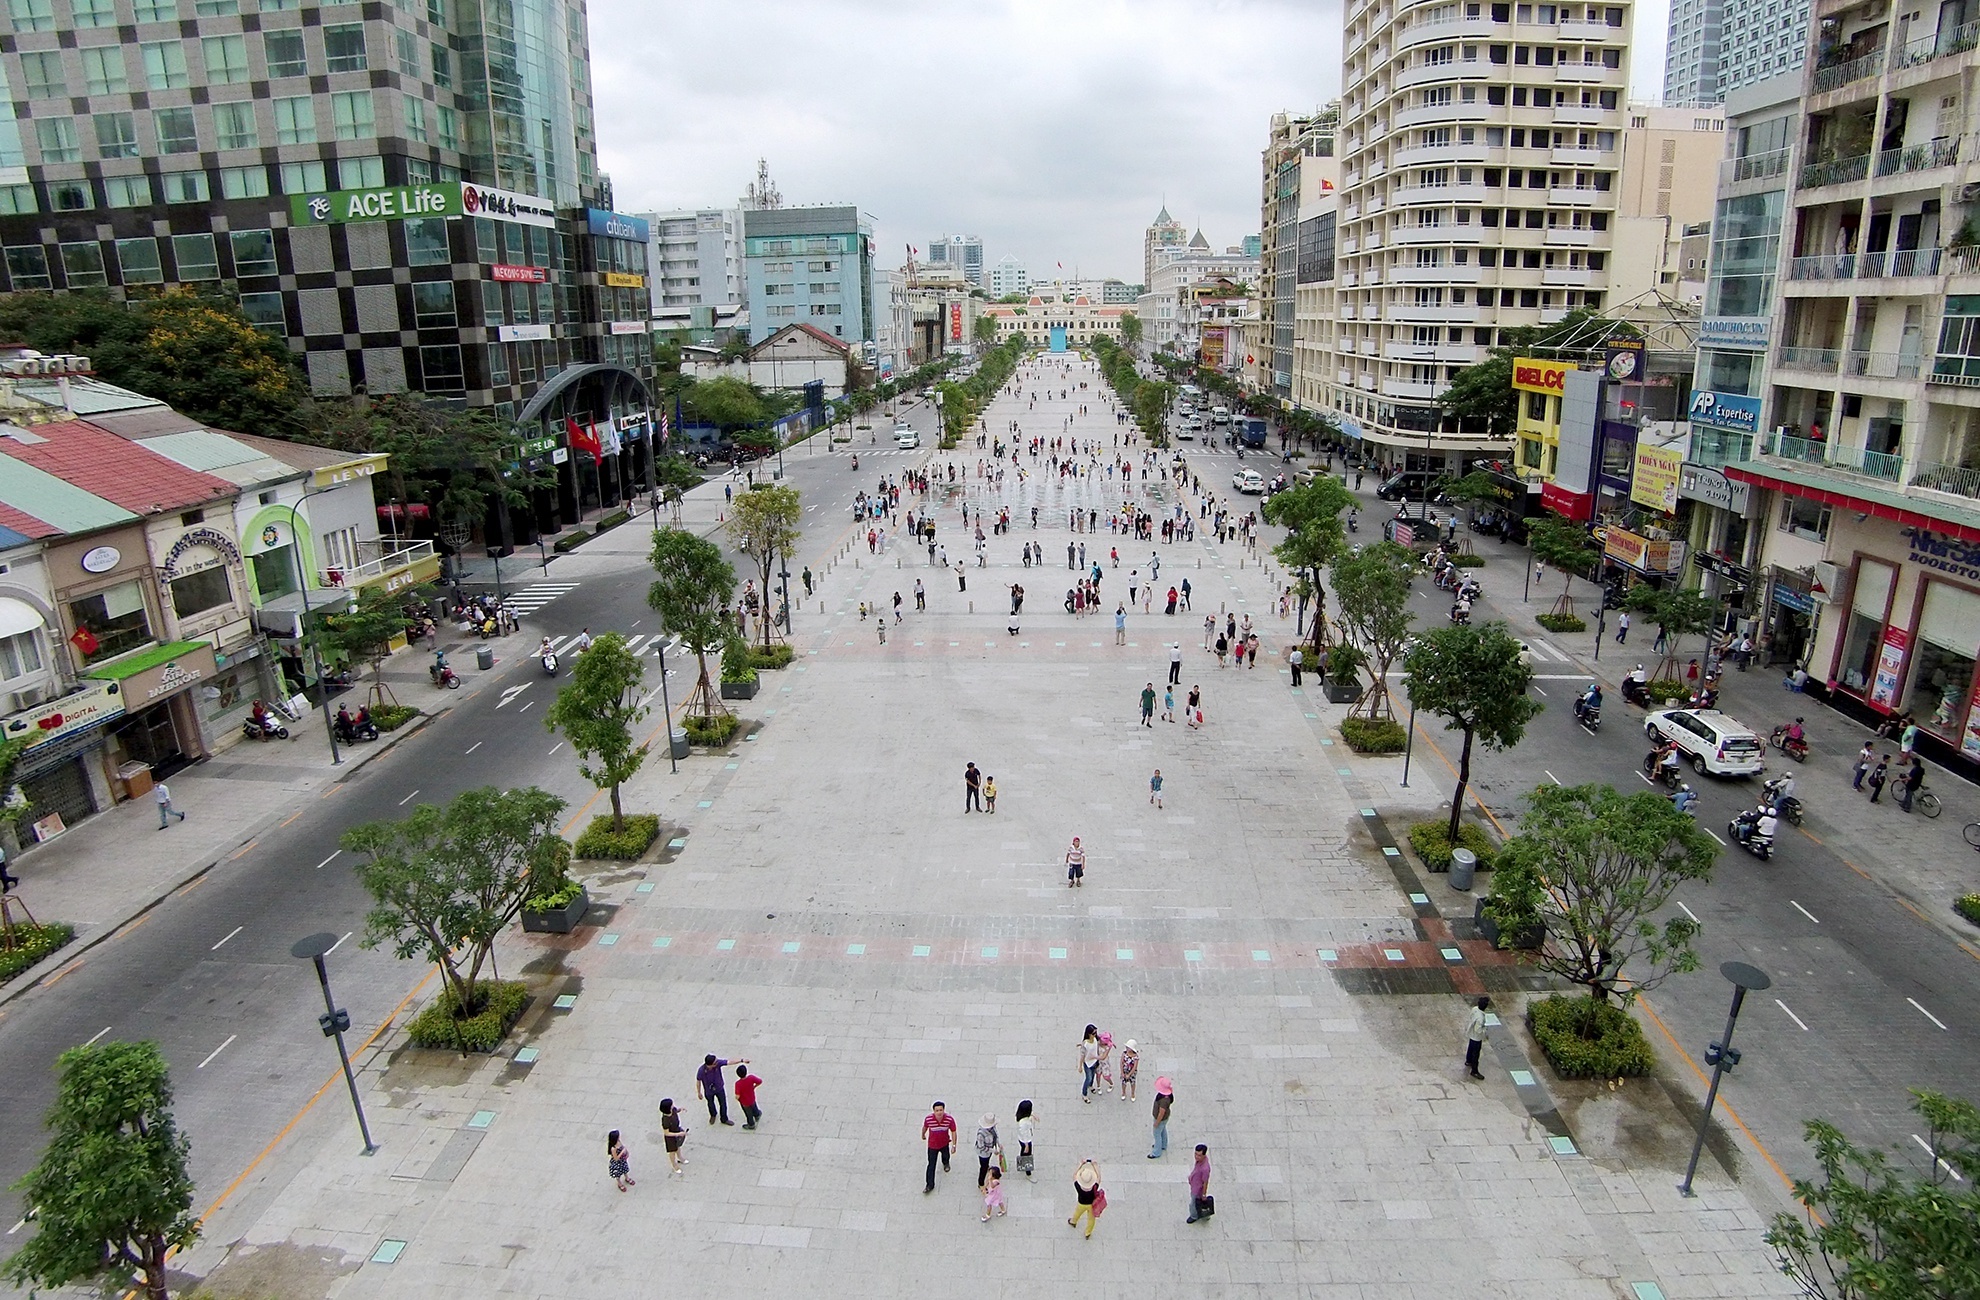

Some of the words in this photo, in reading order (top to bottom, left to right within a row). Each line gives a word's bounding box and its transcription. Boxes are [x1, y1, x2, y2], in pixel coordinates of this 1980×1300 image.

[348, 192, 396, 218] ACE
[401, 188, 446, 214] Life
[606, 216, 636, 238] citibank
[1716, 404, 1754, 421] Expertise
[1697, 473, 1720, 490] TRUNG
[1705, 489, 1731, 502] GROUP
[1909, 552, 1980, 582] BOOKSTO
[64, 704, 98, 723] DIGITAL
